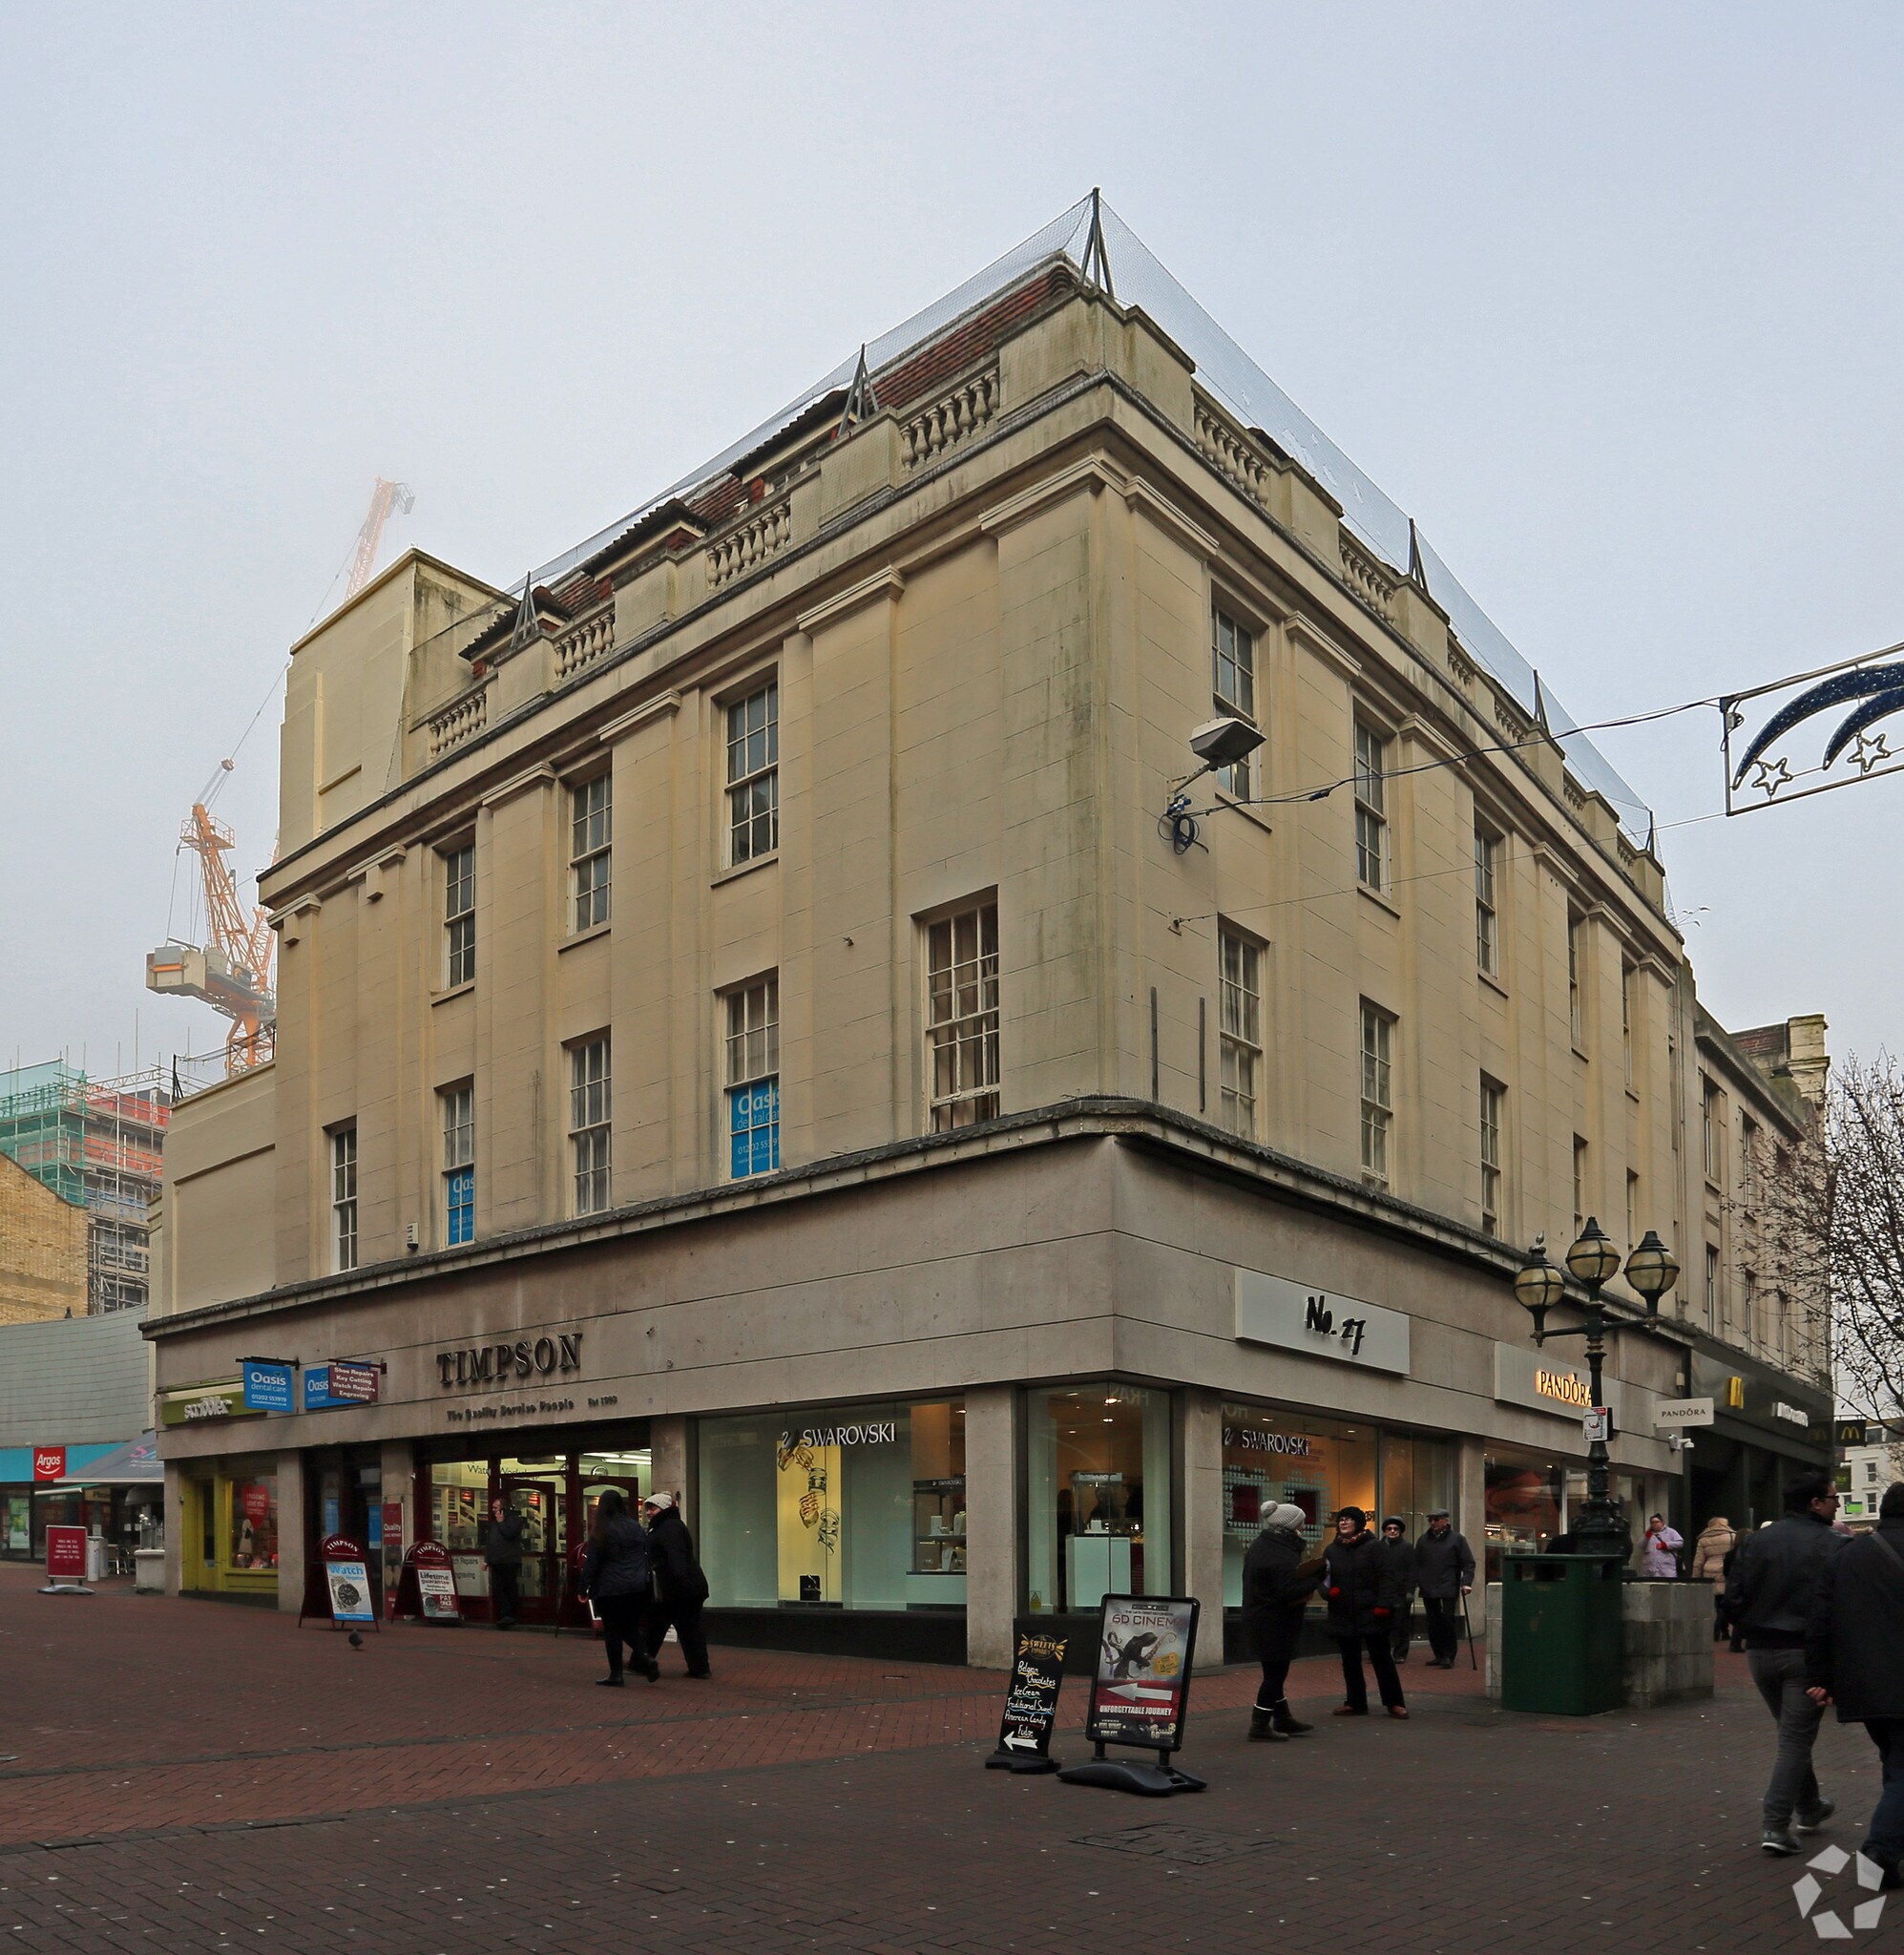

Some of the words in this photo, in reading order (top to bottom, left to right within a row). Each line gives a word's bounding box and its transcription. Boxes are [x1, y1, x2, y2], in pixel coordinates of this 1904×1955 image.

[1341, 1317, 1366, 1356] 27
[436, 1333, 583, 1385] TIMPSON
[251, 1371, 286, 1385] Oasis
[350, 1369, 374, 1377] Repairs
[307, 1379, 329, 1392] Oasis
[349, 1376, 372, 1385] Cutting
[339, 1390, 369, 1400] Engraving
[352, 1384, 376, 1393] Repairs
[447, 1410, 464, 1421] The
[465, 1408, 497, 1421] Quality
[499, 1403, 537, 1417] Service
[538, 1398, 575, 1413] People
[803, 1422, 895, 1448] SWAROVSKI
[1242, 1429, 1309, 1457] SWAROVSKI
[36, 1453, 61, 1469] Argos
[384, 1523, 401, 1533] Quality
[326, 1540, 360, 1553] TIMPSON
[417, 1545, 445, 1556] TIMPSON
[329, 1565, 364, 1575] Watch
[420, 1571, 450, 1581] Lifetime
[1112, 1614, 1130, 1624] 6D
[1029, 1639, 1057, 1652] SWEETS
[1026, 1673, 1057, 1687] Chocolates
[1099, 1705, 1144, 1715] UNFORGETTABLE
[1144, 1706, 1173, 1716] JOURNEY
